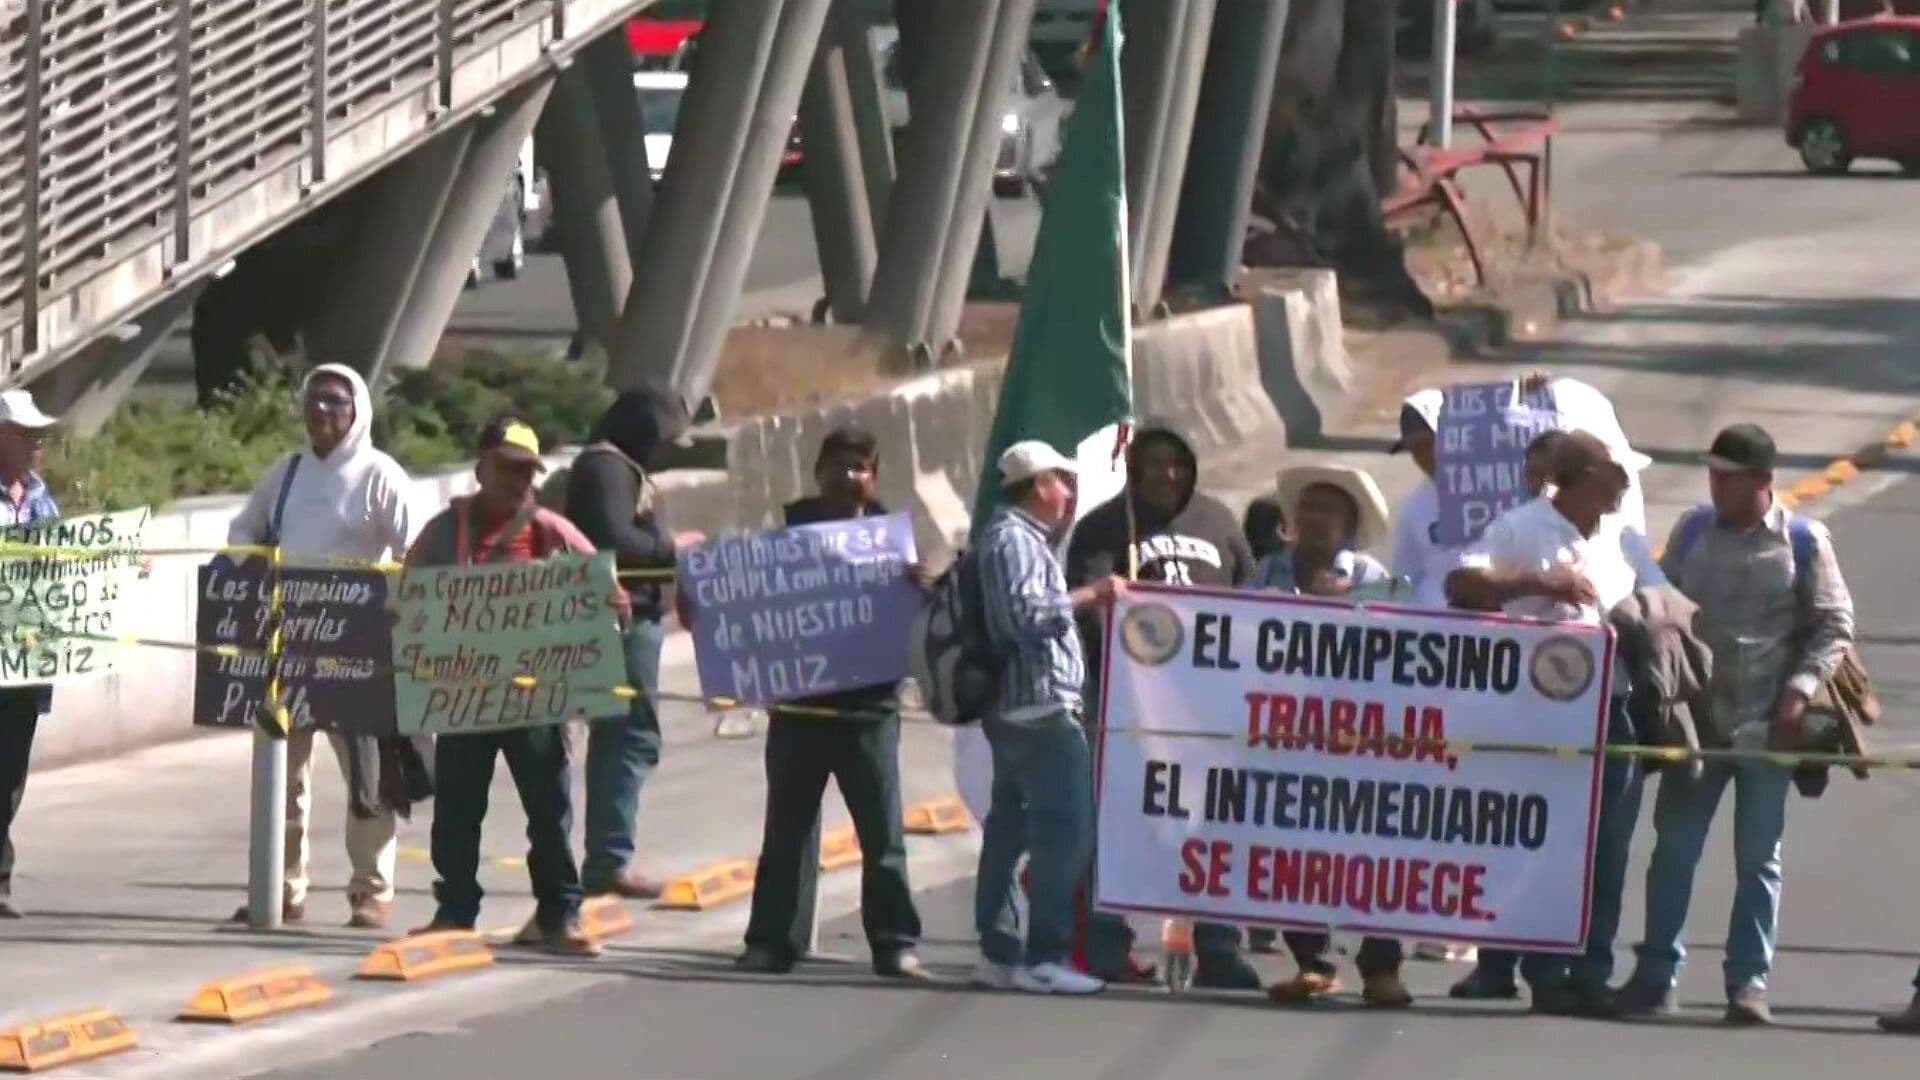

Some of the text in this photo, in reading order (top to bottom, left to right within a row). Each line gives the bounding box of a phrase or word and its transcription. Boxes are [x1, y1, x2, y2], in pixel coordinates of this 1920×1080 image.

[1445, 462, 1523, 496] TAMBI
[443, 591, 601, 635] MORELOS
[752, 594, 873, 644] NUESTRO
[1192, 612, 1522, 695] EL CAMPESINO
[1245, 691, 1459, 771] TRABAJA,
[1143, 760, 1549, 850] EL INTERMEDIARIO
[1179, 837, 1497, 922] SE ENRIQUECE.
